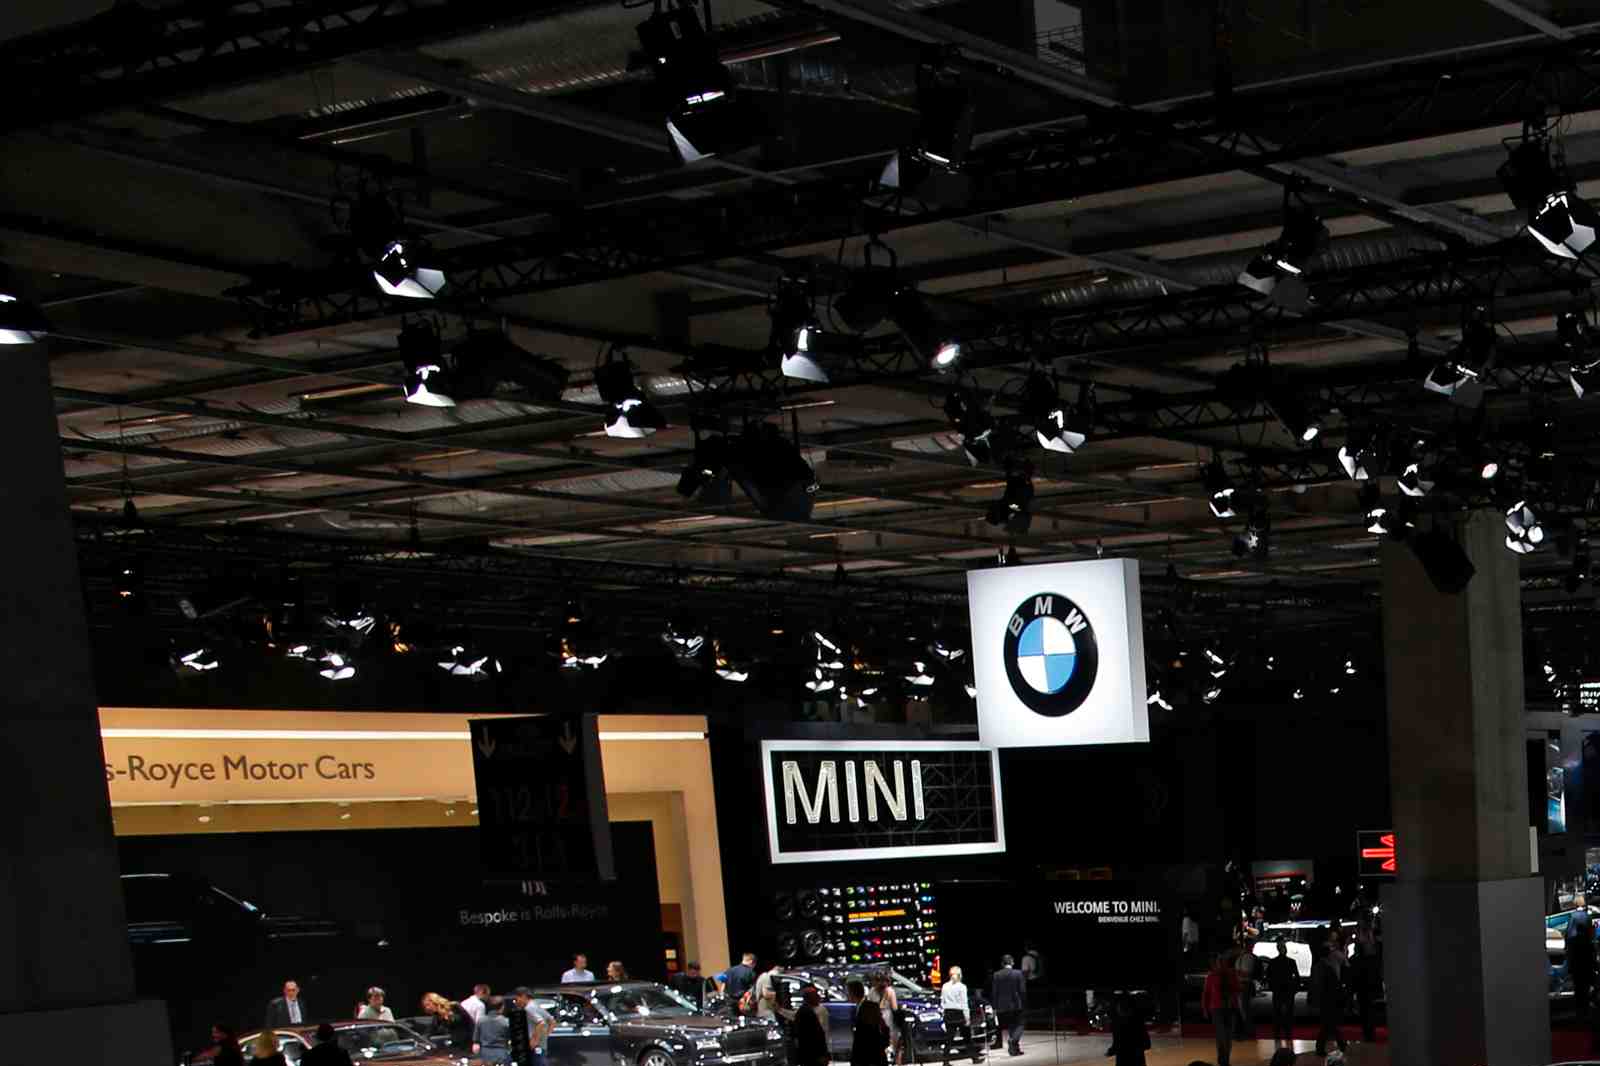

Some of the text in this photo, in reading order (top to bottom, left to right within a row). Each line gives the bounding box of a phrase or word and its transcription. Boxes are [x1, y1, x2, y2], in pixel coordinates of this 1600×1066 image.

[1008, 596, 1088, 637] BMW
[223, 754, 309, 780] Motor
[315, 754, 375, 780] Cars
[782, 759, 925, 824] MINI
[460, 907, 519, 927] Bespoke
[1054, 900, 1161, 914] WELCOME TO MINI.
